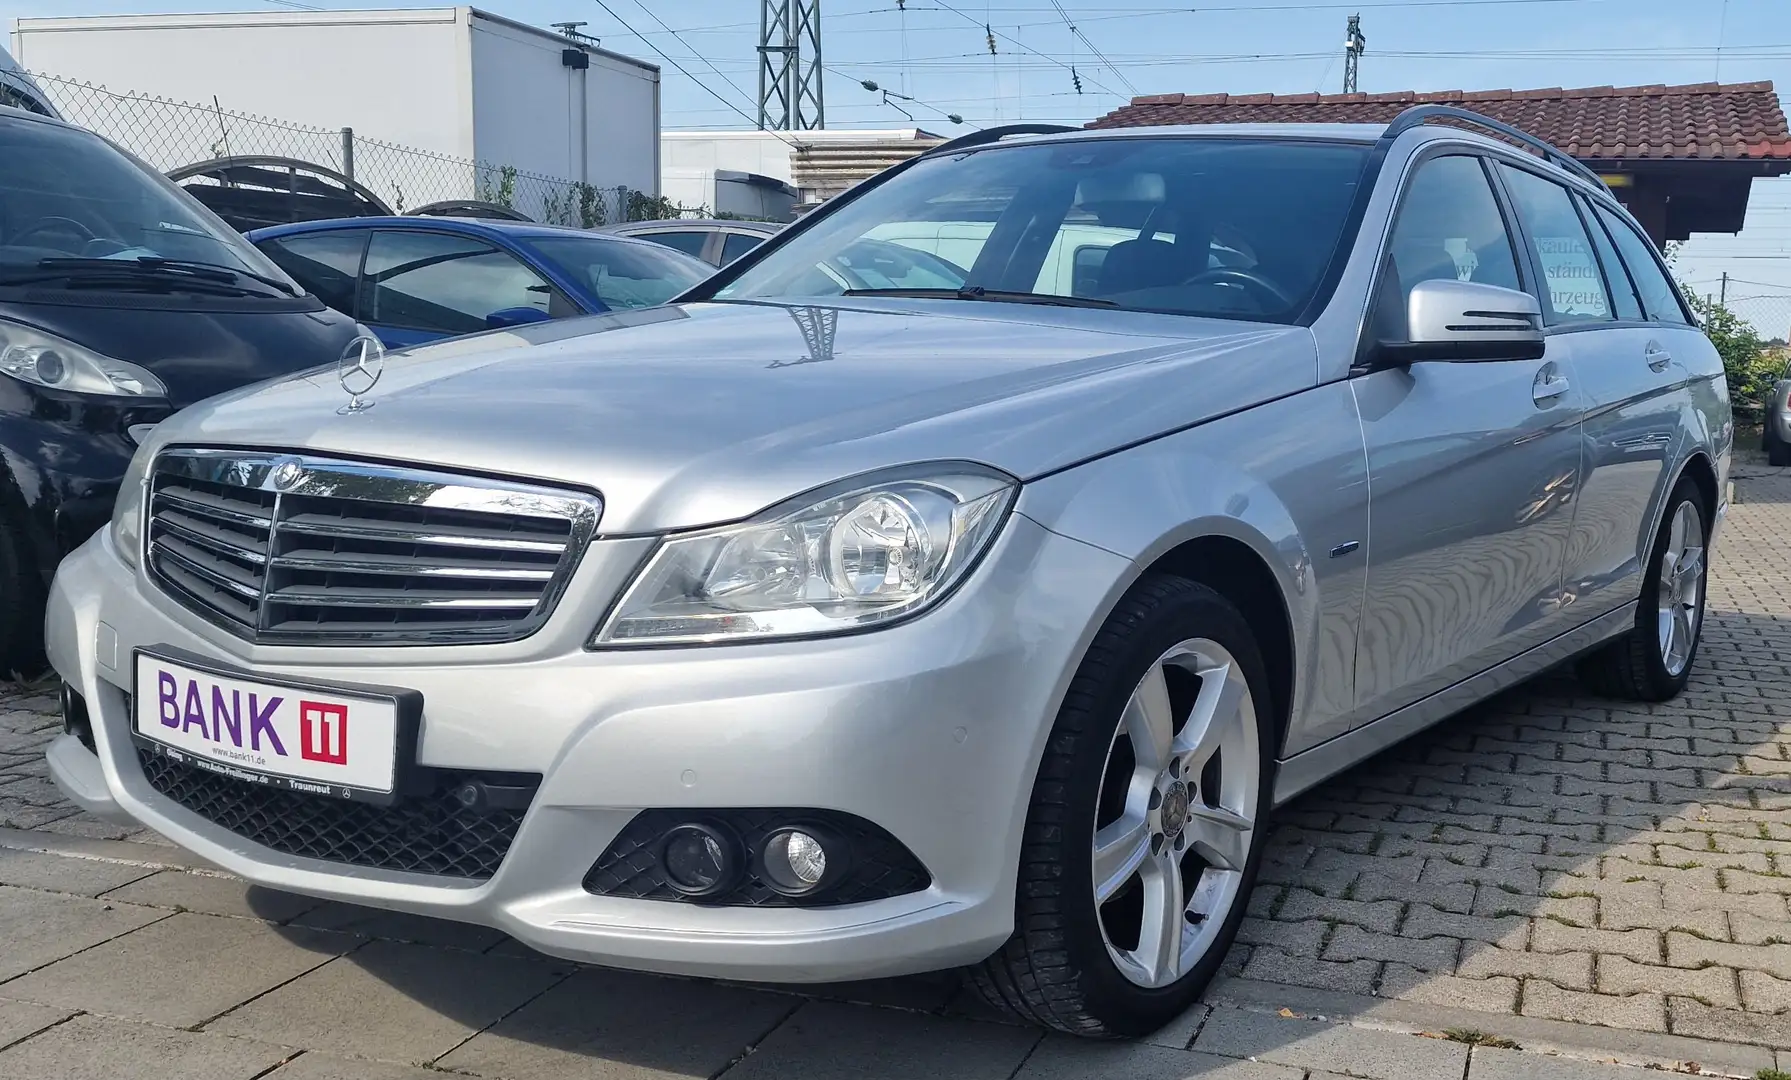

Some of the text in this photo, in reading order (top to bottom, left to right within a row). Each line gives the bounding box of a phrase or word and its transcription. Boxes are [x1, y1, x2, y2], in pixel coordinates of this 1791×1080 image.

[157, 669, 342, 759] BANK 11
[212, 747, 266, 766] www.bank11.de
[288, 779, 331, 795] Traunreut
